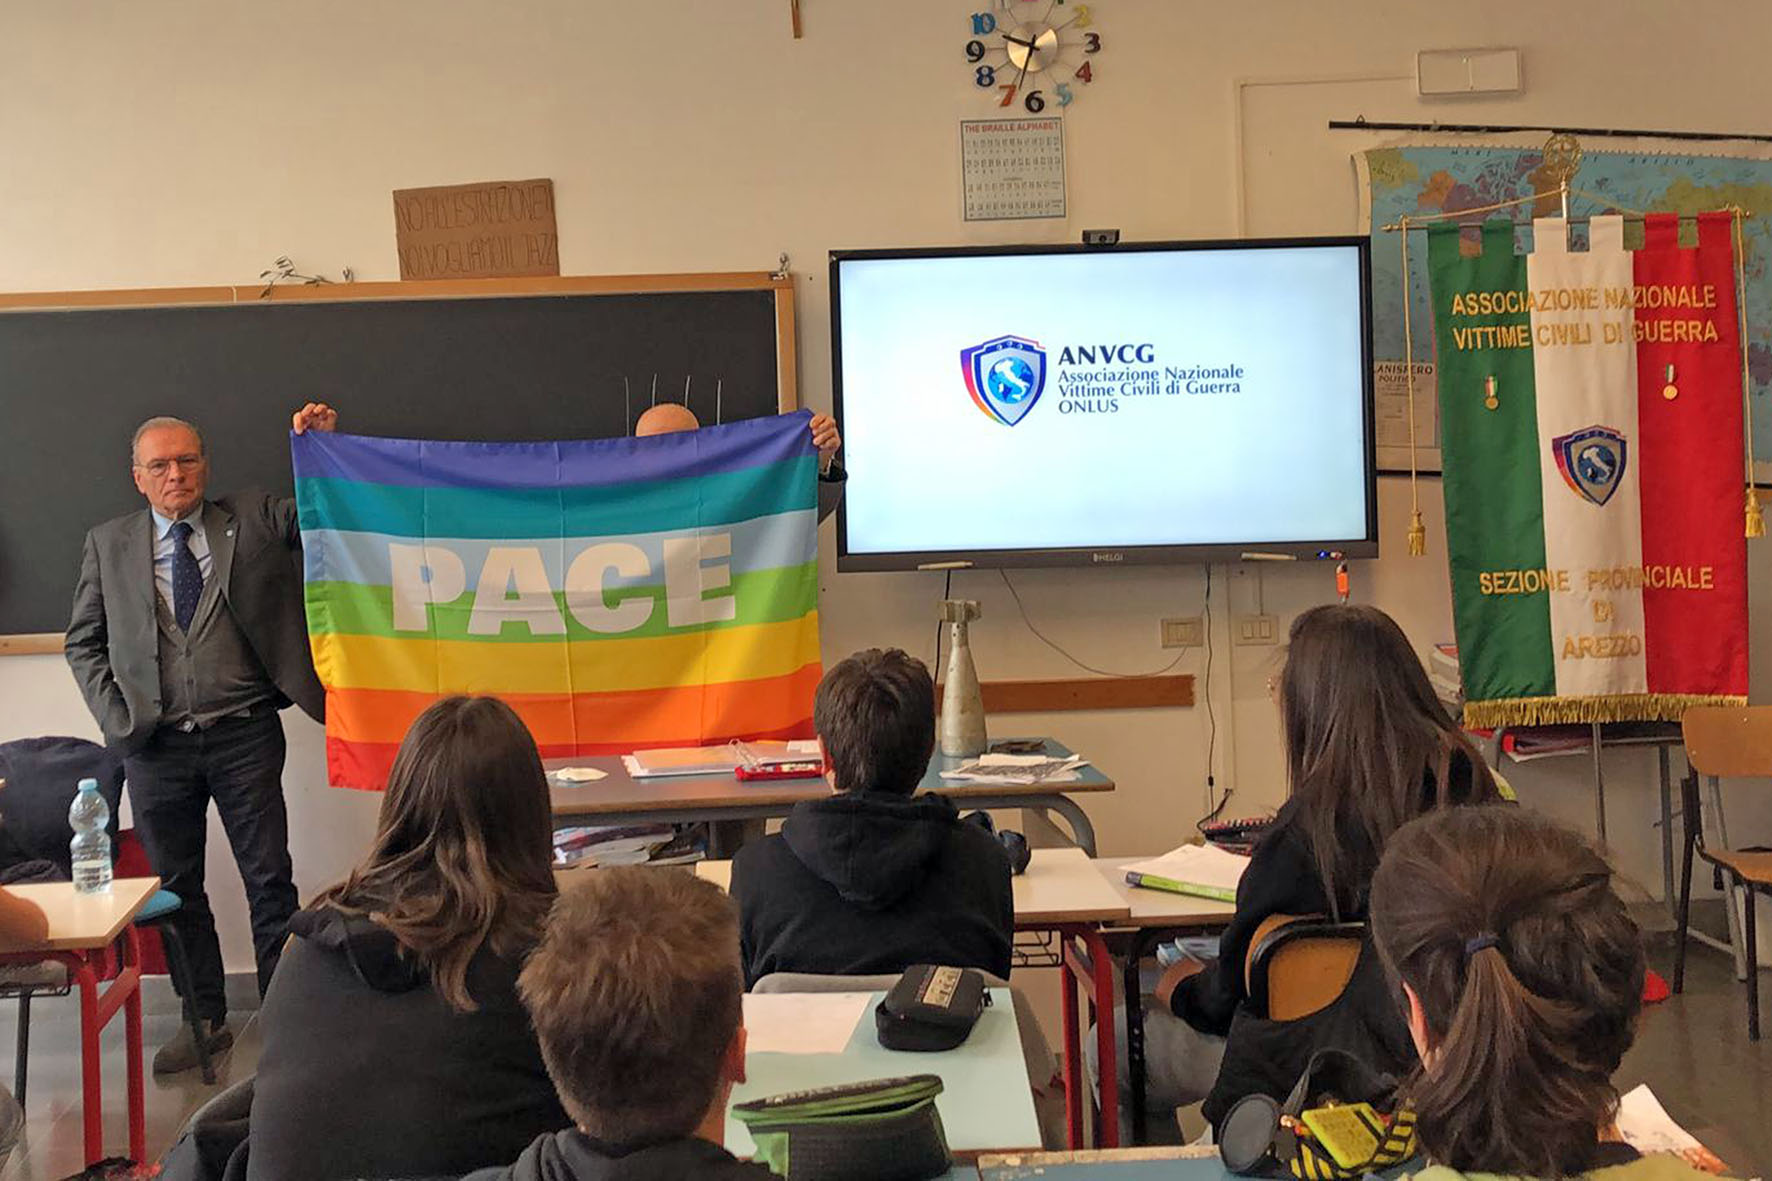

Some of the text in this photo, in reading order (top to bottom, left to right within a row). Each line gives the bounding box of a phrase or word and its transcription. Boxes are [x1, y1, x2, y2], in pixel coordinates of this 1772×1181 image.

[971, 13, 995, 35] 10
[1074, 5, 1090, 28] 2
[966, 40, 985, 63] 9
[1084, 33, 1101, 53] 3
[976, 65, 995, 87] 8
[1075, 61, 1092, 83] 4
[999, 84, 1017, 107] 7
[1025, 90, 1045, 113] 6
[1055, 83, 1073, 107] 5
[964, 120, 1059, 134] THE BRAILLE ALPHABET
[1451, 284, 1717, 316] ASSOCIAZIONE NAZIONALE
[1453, 319, 1719, 352] VITTIME CIVILI DI GUERRA
[1058, 344, 1155, 365] ANVCG
[1058, 364, 1244, 383] Associazione Nazionale
[1058, 381, 1241, 398] Vittime Civili di Guerra
[1058, 399, 1119, 414] ONLUS
[389, 533, 735, 636] PACE
[1479, 566, 1714, 595] SEZIONE PROVINCIALE
[1592, 601, 1614, 623] DI
[1562, 635, 1642, 660] AREZZO
